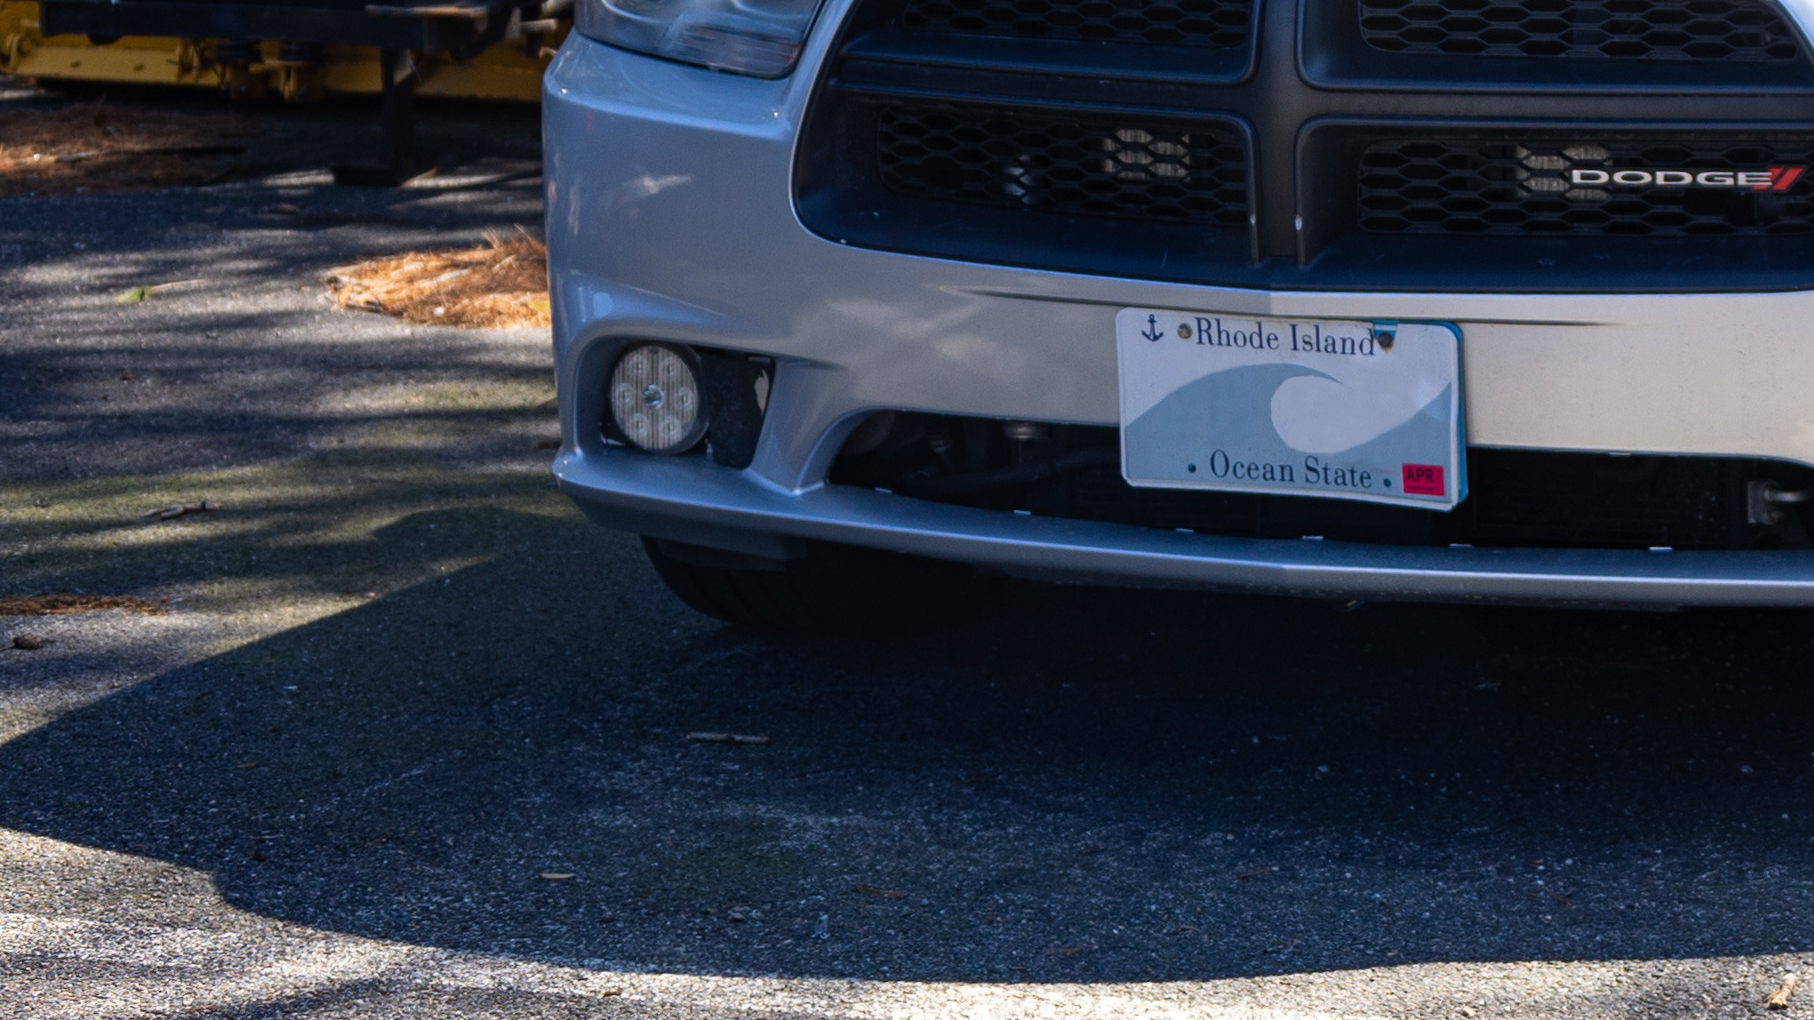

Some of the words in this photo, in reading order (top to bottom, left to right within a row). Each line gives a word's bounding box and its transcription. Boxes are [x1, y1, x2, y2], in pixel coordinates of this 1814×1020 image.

[1571, 169, 1773, 186] DODGE
[1194, 316, 1280, 350] Rhode
[1289, 323, 1376, 356] Island
[1210, 449, 1295, 482] Ocean
[1304, 454, 1372, 488] State
[1407, 467, 1434, 484] APR
